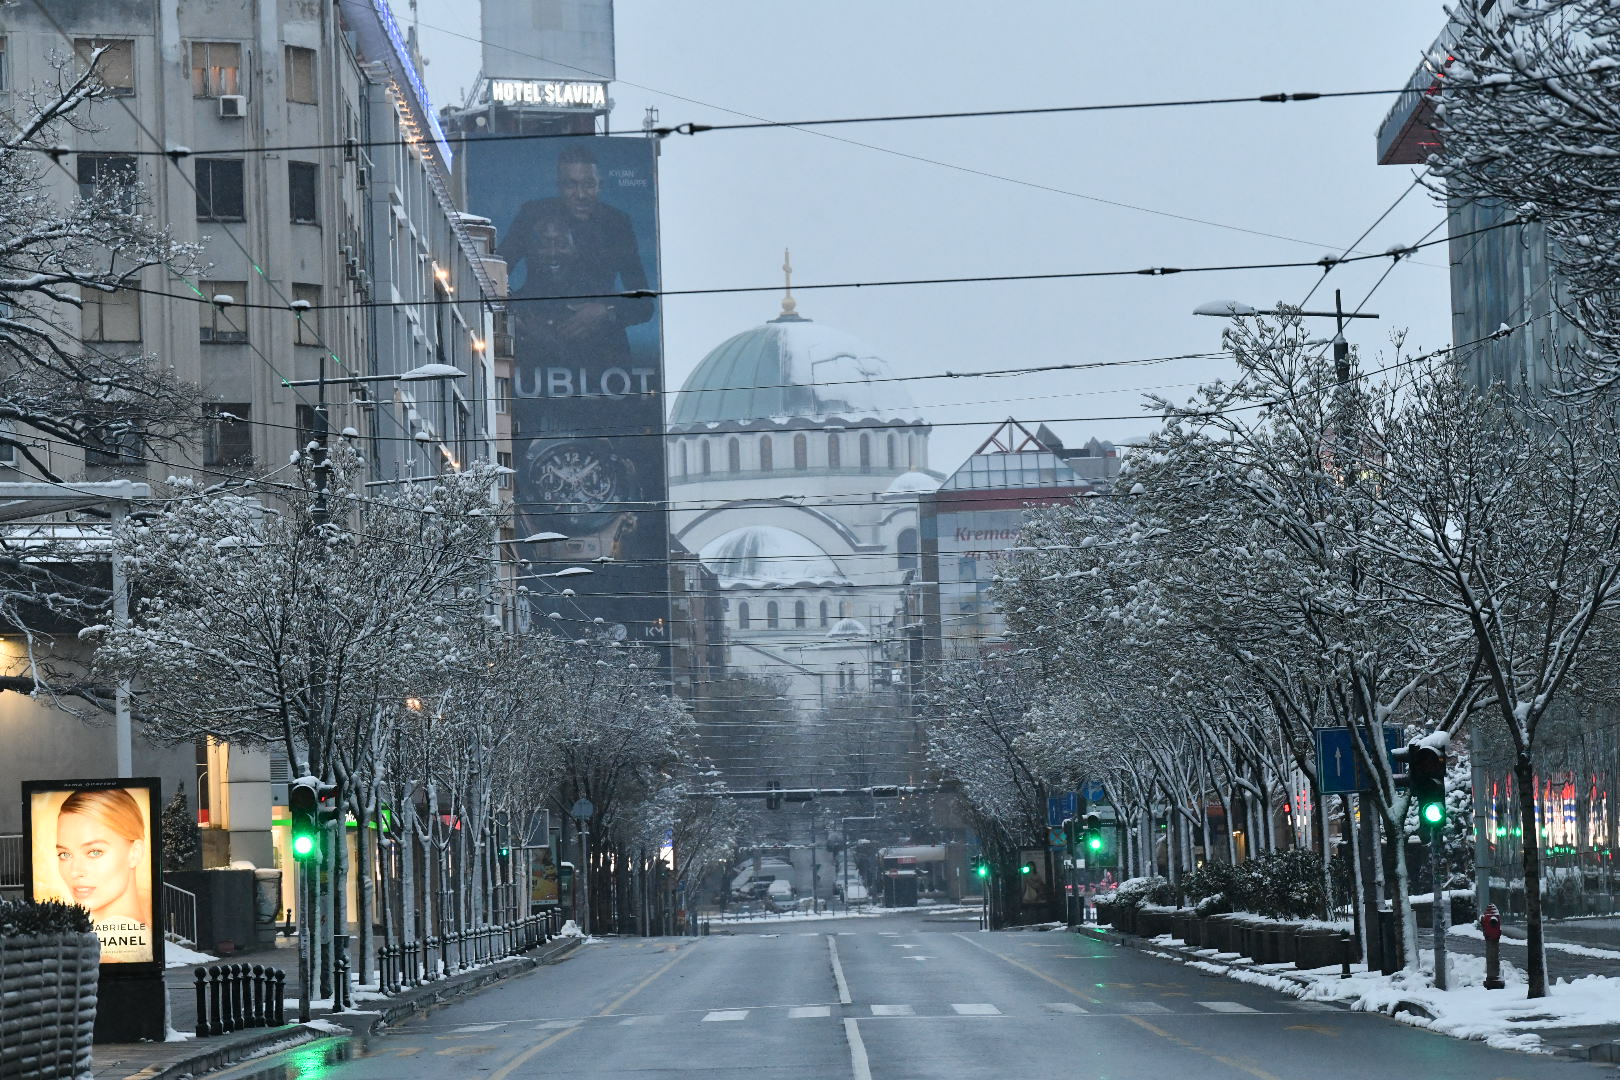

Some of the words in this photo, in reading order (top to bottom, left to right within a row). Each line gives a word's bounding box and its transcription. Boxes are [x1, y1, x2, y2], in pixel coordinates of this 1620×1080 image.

[493, 81, 541, 102] HOTEL
[544, 83, 605, 104] SLAVIJA
[514, 367, 655, 400] UBLOT
[955, 527, 1022, 541] Kremas
[93, 922, 146, 931] ABRIELLE
[98, 936, 146, 946] HANEL
